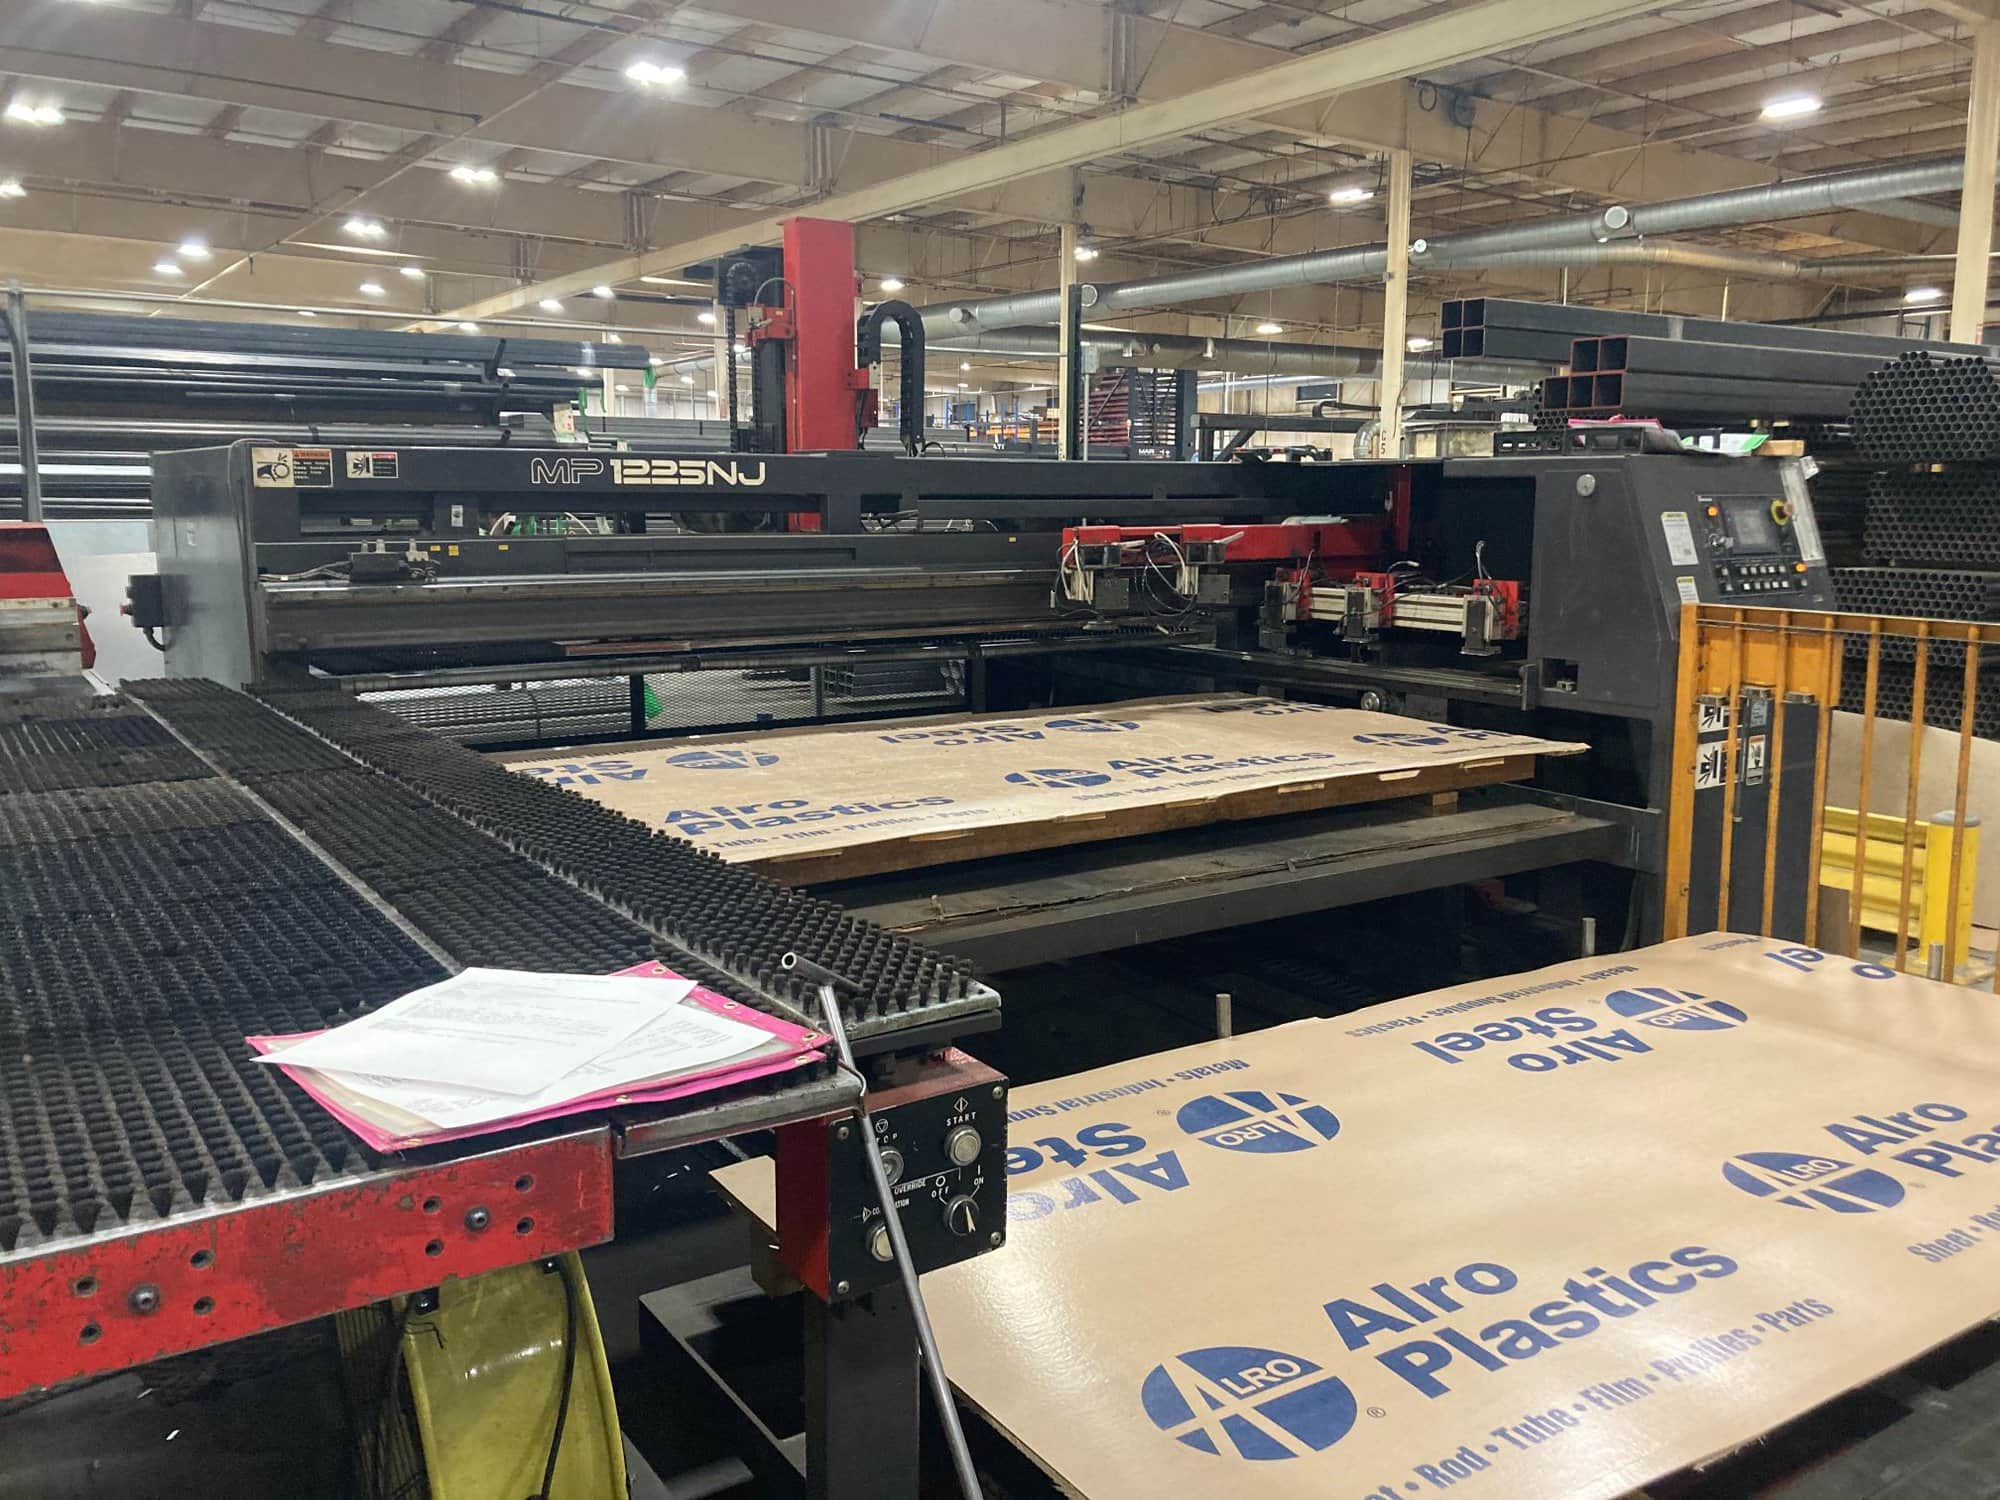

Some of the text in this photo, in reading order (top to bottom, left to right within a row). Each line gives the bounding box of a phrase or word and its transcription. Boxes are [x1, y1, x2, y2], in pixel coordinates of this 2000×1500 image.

[531, 457, 766, 486] MP 1225NJ
[1107, 753, 1215, 770] Alro
[1131, 752, 1335, 780] Plastics
[665, 799, 809, 824] Alro
[677, 796, 955, 836] Plastics
[1412, 1006, 1598, 1065] Steel
[1507, 1028, 1655, 1073] Alro
[1176, 1059, 1252, 1081] Metals
[1054, 1079, 1167, 1111] Industrial
[946, 1111, 977, 1127] START
[1823, 1103, 1968, 1155] Alro
[1889, 1124, 2000, 1178] Pla
[931, 1186, 950, 1199] OFF
[973, 1176, 984, 1186] ON
[1907, 1228, 1982, 1263] Sheet
[1322, 1262, 1518, 1352] Alro
[1375, 1246, 1738, 1399] Plastics
[1412, 1296, 1836, 1489] Rod Tube Film Profiles Parts
